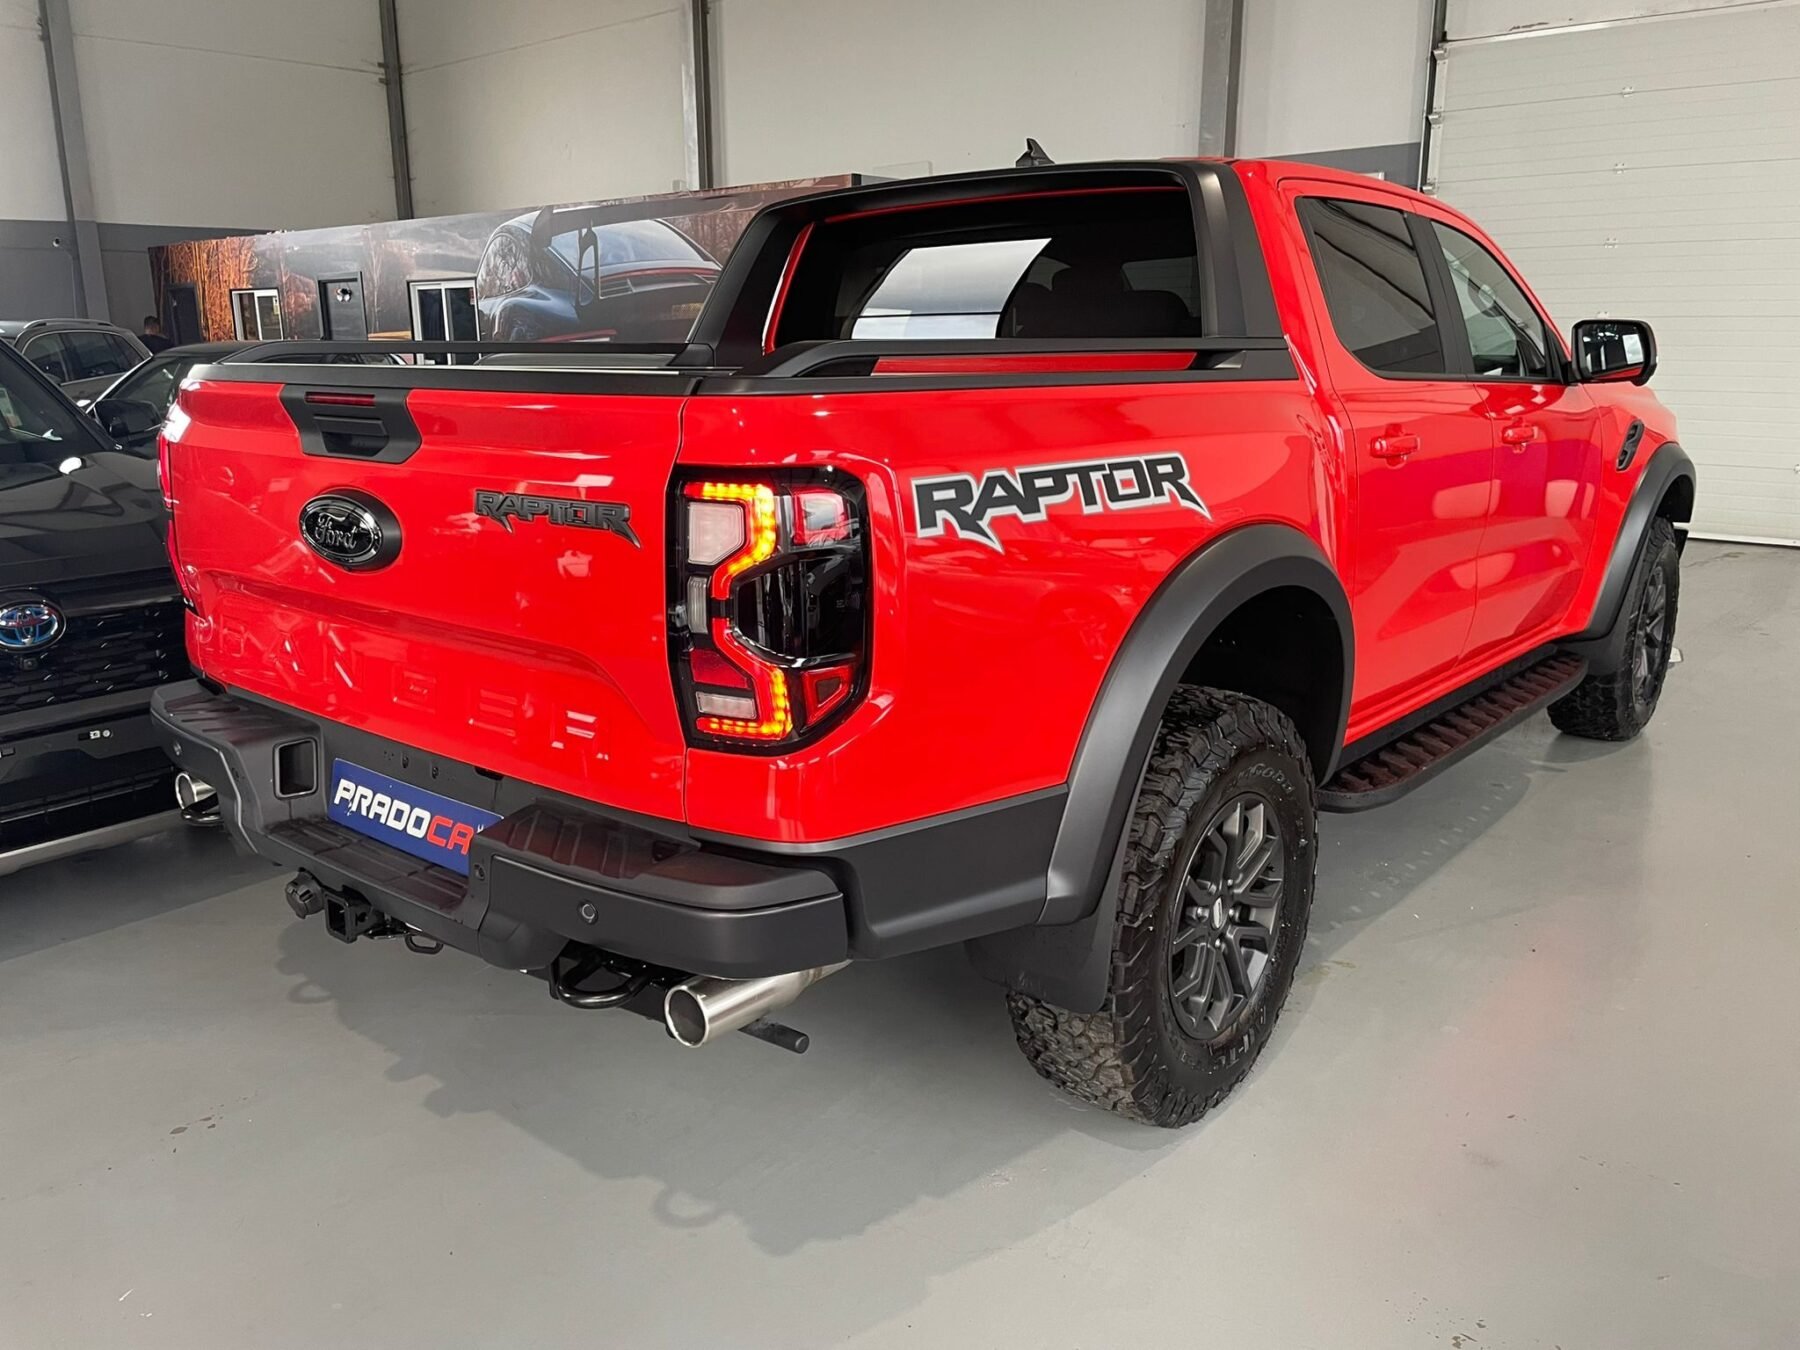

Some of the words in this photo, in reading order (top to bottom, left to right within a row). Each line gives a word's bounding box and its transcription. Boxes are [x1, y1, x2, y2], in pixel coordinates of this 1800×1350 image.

[314, 512, 357, 549] Ford
[475, 489, 641, 548] RAPTOR
[911, 452, 1213, 555] RAPTOR
